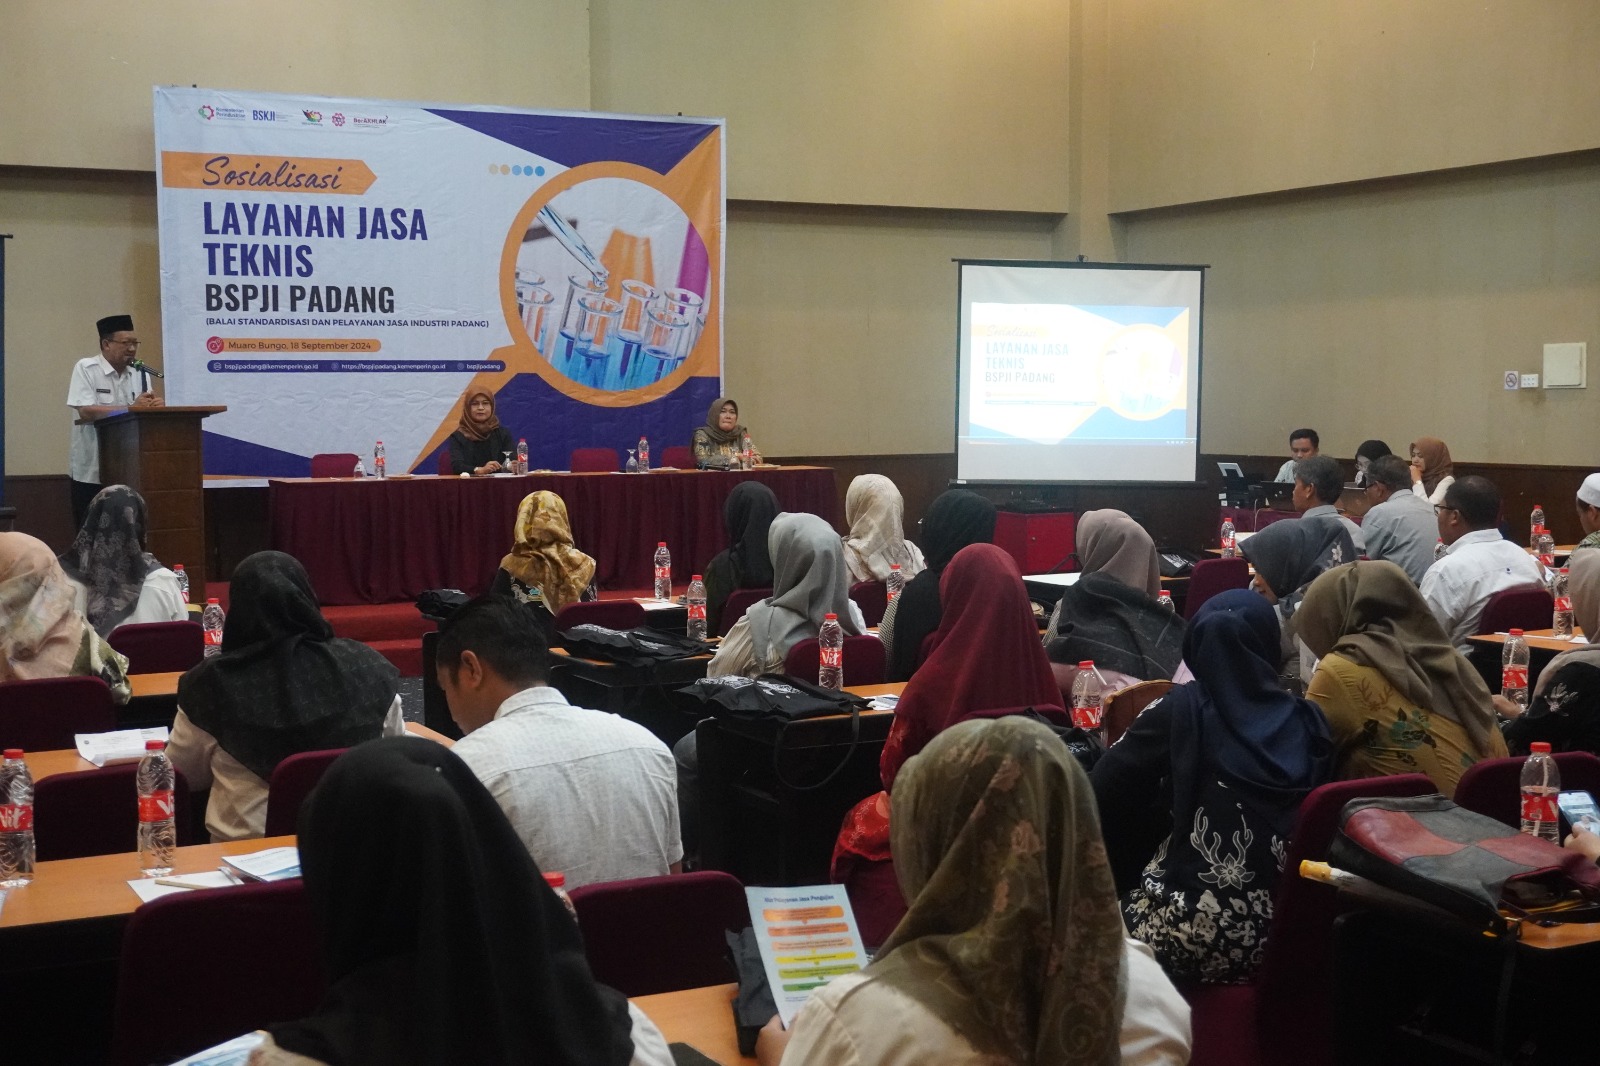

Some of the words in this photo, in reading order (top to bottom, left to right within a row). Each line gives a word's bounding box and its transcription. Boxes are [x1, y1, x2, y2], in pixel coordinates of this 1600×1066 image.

[252, 109, 276, 121] BSKJI
[202, 155, 342, 190] Sosialisasi
[203, 201, 345, 239] LAYANAN
[356, 206, 428, 241] JASA
[203, 242, 314, 278] TEKNIS
[205, 283, 279, 313] BSPJI
[290, 285, 395, 314] PADANG
[206, 318, 236, 326] (BALAI
[238, 318, 310, 326] STANDARDISASI
[332, 319, 386, 327] PELAYANAN
[387, 319, 409, 327] JASA
[451, 320, 490, 328] PADANG)
[228, 341, 256, 350] Muaro
[258, 341, 289, 352] Bungo,
[290, 341, 300, 350] 18
[301, 341, 349, 352] September
[350, 342, 371, 350] 2024
[986, 341, 1038, 355] LAYANAN
[1042, 343, 1069, 356] JASA
[985, 356, 1025, 369] TEKNIS
[985, 371, 1012, 383] BSPJI
[1015, 371, 1055, 383] PADANG
[821, 650, 840, 666] Vit
